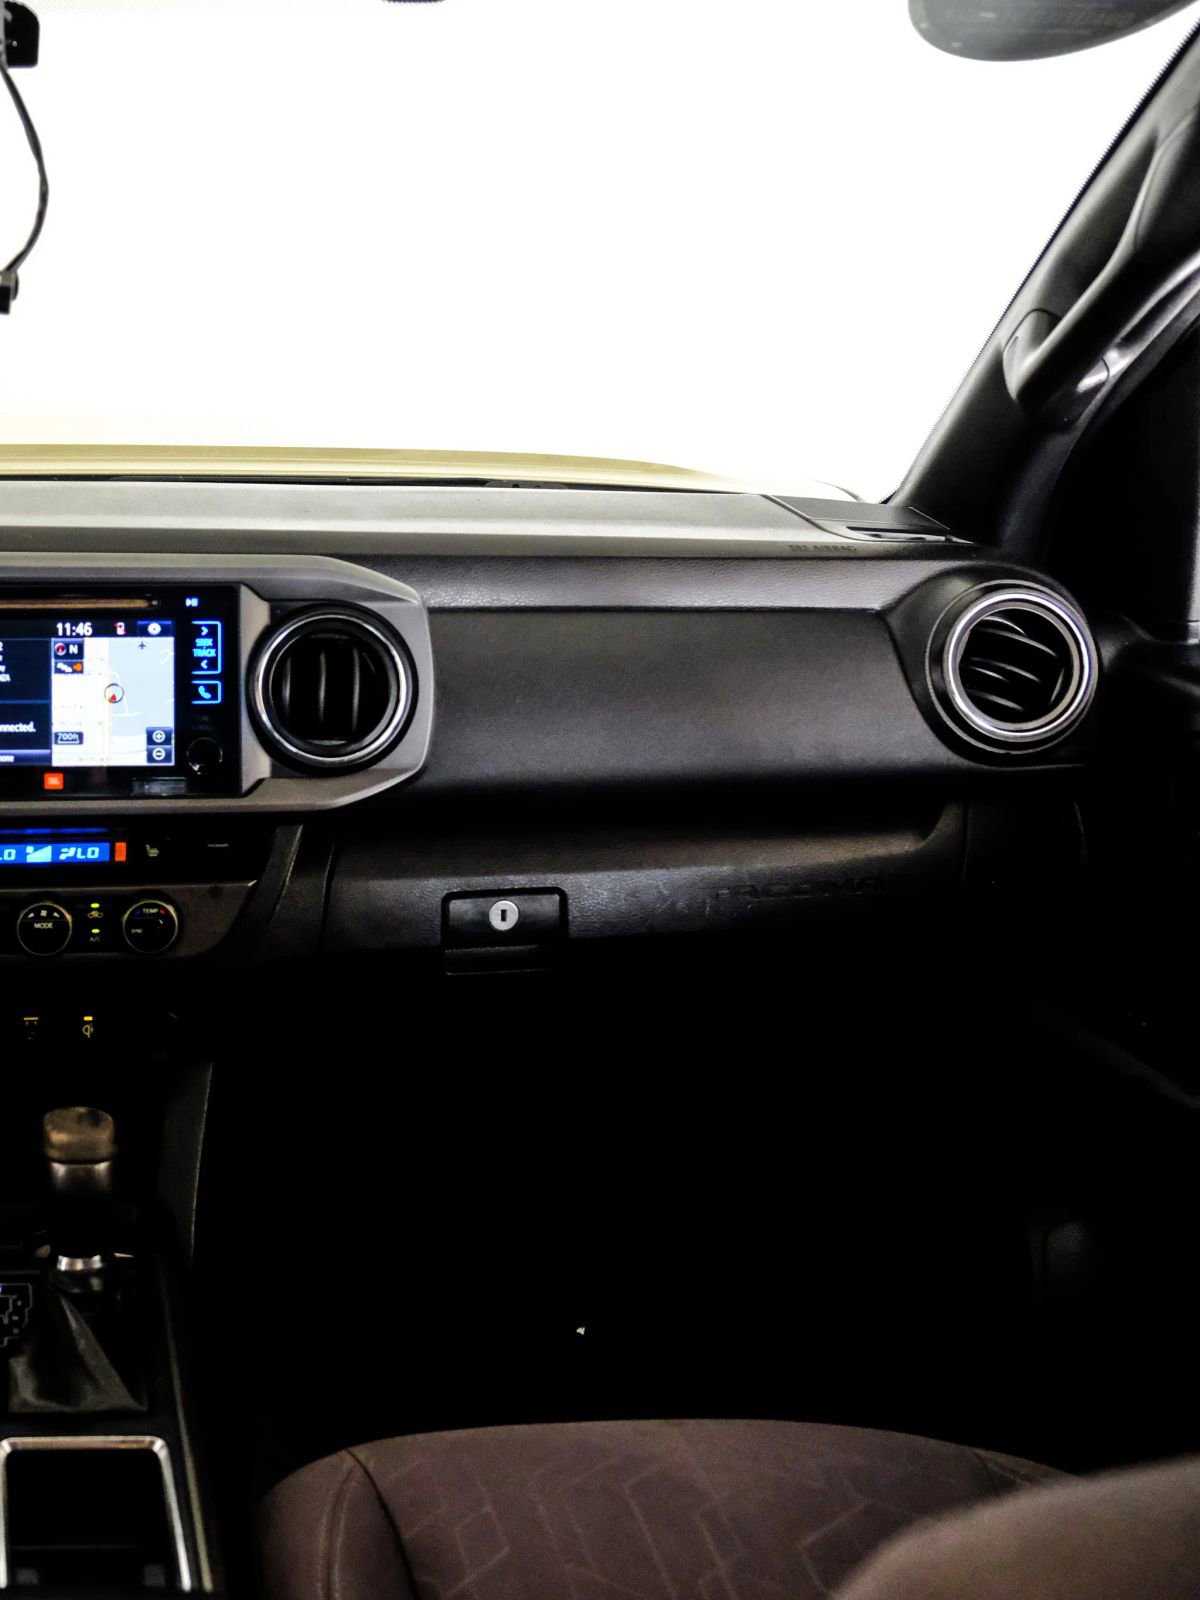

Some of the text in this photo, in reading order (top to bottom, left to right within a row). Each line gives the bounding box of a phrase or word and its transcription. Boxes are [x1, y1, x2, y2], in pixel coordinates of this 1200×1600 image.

[56, 622, 93, 636] 11:46
[195, 638, 213, 646] SEEK
[68, 644, 79, 654] N
[192, 648, 216, 657] TRACK
[57, 733, 79, 741] 700ft
[76, 846, 100, 859] LO
